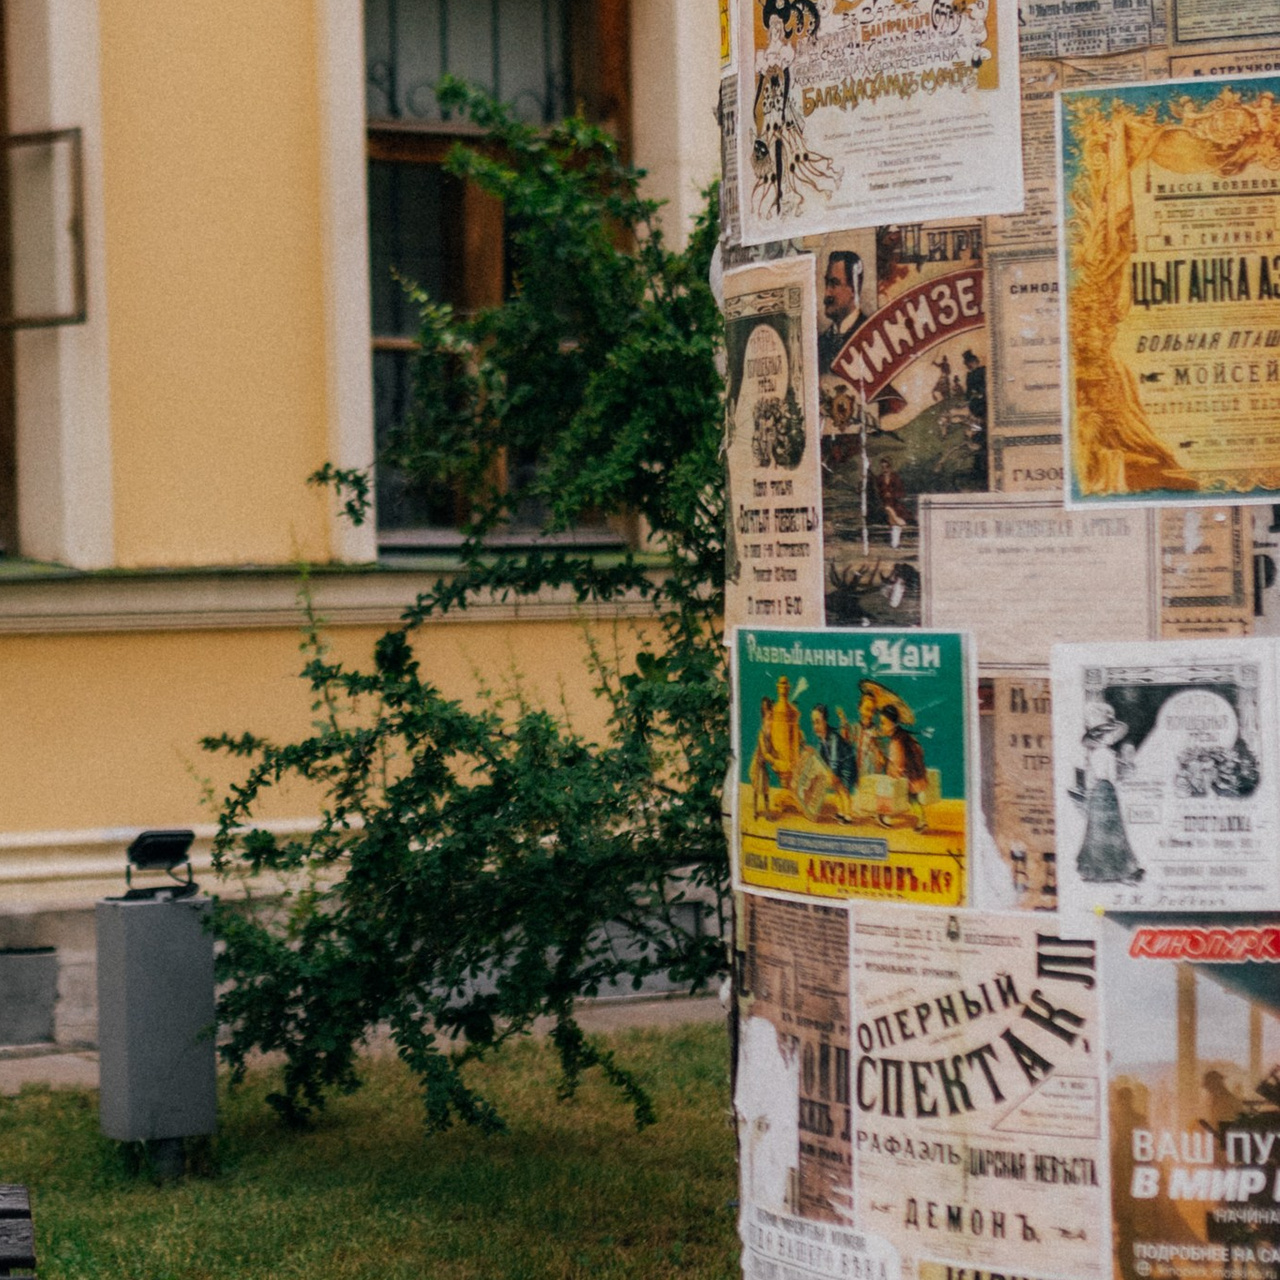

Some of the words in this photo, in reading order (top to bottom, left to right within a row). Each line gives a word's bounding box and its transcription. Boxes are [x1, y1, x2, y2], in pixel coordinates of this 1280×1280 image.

[1132, 256, 1251, 311] ЦЫГАНКА
[1136, 331, 1222, 354] ВОЛЬНАЯ
[1133, 932, 1277, 957] КИНОПАРК
[857, 972, 1021, 1053] ОПЕРНЫЙ
[857, 1130, 962, 1166] РАФАЭЛЬ
[1132, 1128, 1215, 1165] ВАШ
[1225, 1130, 1280, 1165] ПУ
[1131, 1166, 1160, 1199] В
[1167, 1168, 1267, 1203] МИР
[1133, 1242, 1229, 1263] ПОДРОБНЕЕ
[1232, 1247, 1256, 1263] НА
